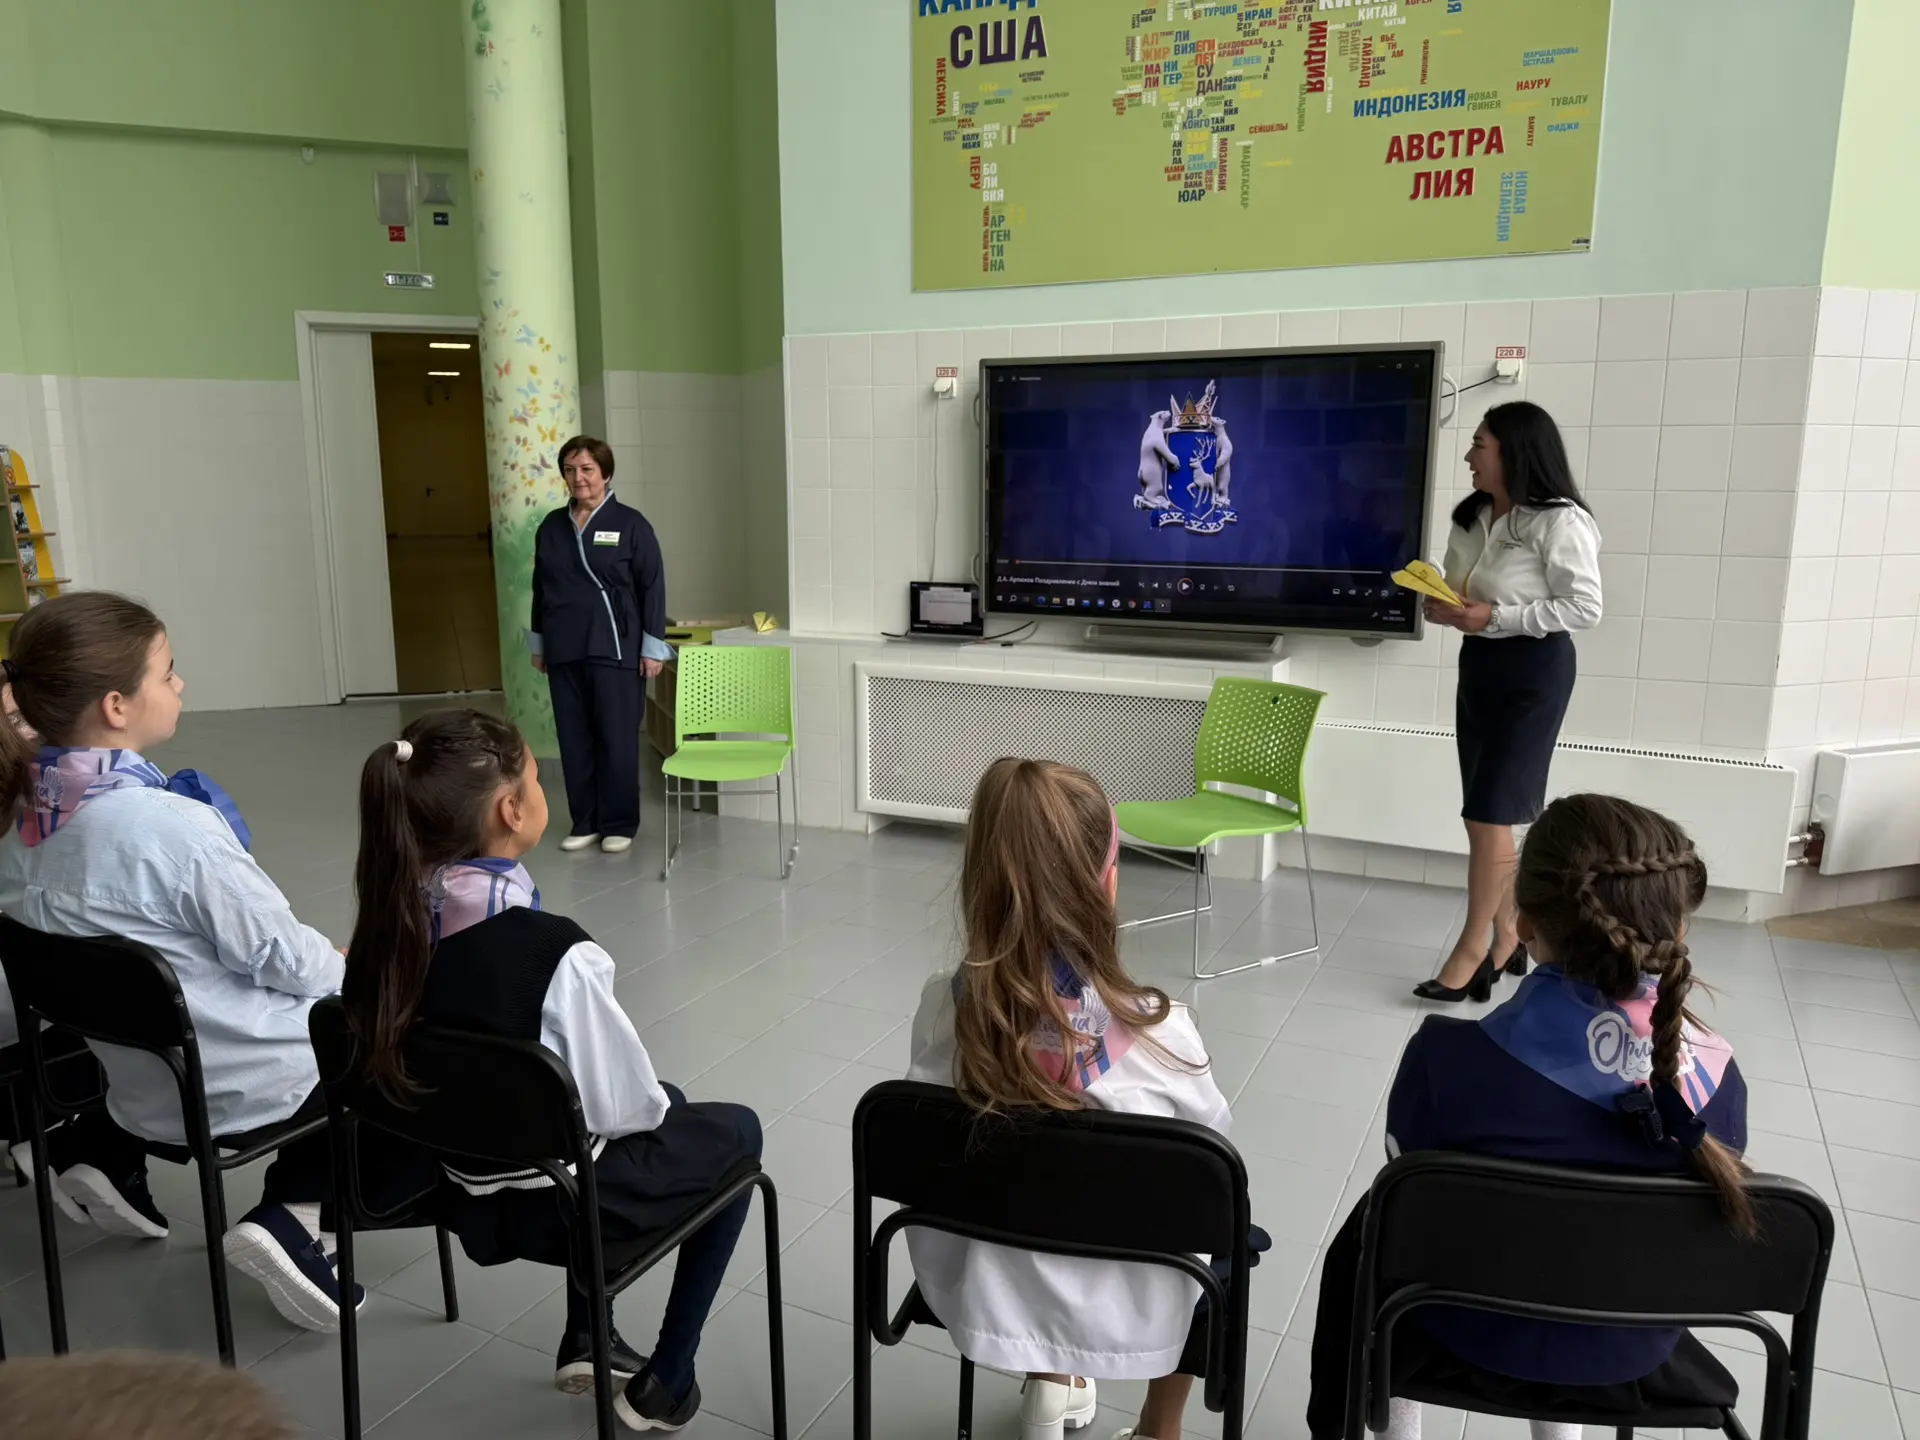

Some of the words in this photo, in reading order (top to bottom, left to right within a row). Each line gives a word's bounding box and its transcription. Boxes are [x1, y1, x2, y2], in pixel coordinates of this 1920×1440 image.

[1204, 4, 1238, 17] ТУРЦИЯ
[1244, 7, 1273, 21] ИРАН
[1303, 5, 1314, 13] КИ
[1358, 2, 1397, 21] КИТАЙ
[1297, 14, 1312, 23] СТА
[1384, 16, 1406, 27] КИТАЙ
[1278, 22, 1288, 30] АН
[1297, 24, 1303, 32] Н
[1142, 32, 1160, 46] АЛ
[1174, 30, 1190, 42] ЛИ
[1243, 28, 1260, 38] ВЕЙТ
[1380, 33, 1396, 42] ВЬЕ
[950, 16, 1048, 69] США
[1174, 42, 1196, 56] ВИЯ
[1195, 38, 1216, 52] ЕГИ
[1338, 30, 1350, 57] ДЕШ
[1387, 42, 1397, 50] ТН
[1142, 47, 1171, 62] ЖИР
[1304, 20, 1329, 93] ИНДИЯ
[1349, 29, 1361, 72] БАНГЛА
[1391, 49, 1404, 58] АМ
[1195, 51, 1216, 65] ПЕТ
[1359, 36, 1374, 88] ТАЙЛАНД
[1144, 63, 1161, 75] МА
[1163, 60, 1178, 72] НИ
[1197, 63, 1214, 79] СУ
[1144, 76, 1160, 88] ЛИ
[1163, 73, 1183, 86] ГЕР
[1516, 77, 1551, 91] НАУРУ
[936, 57, 947, 116] МЕКСИКА
[1196, 78, 1224, 96] ДАН
[1186, 97, 1205, 109] ЦАР
[1224, 99, 1233, 107] КЕ
[1467, 91, 1498, 102] НОВАЯ
[1551, 95, 1588, 107] ТУВАЛУ
[1353, 89, 1467, 118] ИНДОНЕЗИЯ
[1466, 99, 1501, 111] ГВИНЕЯ
[1187, 109, 1205, 120] Д.Р.
[1224, 107, 1239, 116] НИЯ
[1182, 118, 1210, 130] КОНГО
[1211, 116, 1225, 125] ТАН
[1547, 122, 1579, 132] ФИДЖИ
[1210, 124, 1236, 134] ЗАНИЯ
[1249, 123, 1288, 134] СЕЙШЕЛЫ
[1526, 115, 1536, 147] ВАНУАТУ
[1172, 140, 1182, 148] АН
[1384, 125, 1506, 165] АВСТРА
[1172, 148, 1182, 157] ГО
[1172, 157, 1182, 165] ЛА
[1218, 137, 1229, 192] МОЗАМБИК
[970, 156, 981, 190] ПЕРУ
[983, 163, 997, 176] БО
[1164, 165, 1185, 174] НАМИ
[983, 176, 998, 189] ЛИ
[1167, 174, 1182, 182] БИЯ
[1184, 172, 1203, 181] БОТС
[1240, 146, 1251, 210] МАДАГАСКАР
[1184, 181, 1203, 189] ВАНА
[1409, 167, 1476, 202] ЛИЯ
[983, 189, 1004, 202] ВИЯ
[1178, 189, 1206, 203] ЮАР
[1513, 170, 1528, 215] НОВАЯ
[1496, 172, 1514, 242] ЗЕЛАНДИЯ
[990, 215, 1005, 228] АР
[990, 229, 1011, 243] ГЕН
[990, 244, 1004, 257] ТИ
[990, 259, 1005, 272] НА
[1035, 577, 1076, 587] Поздравление
